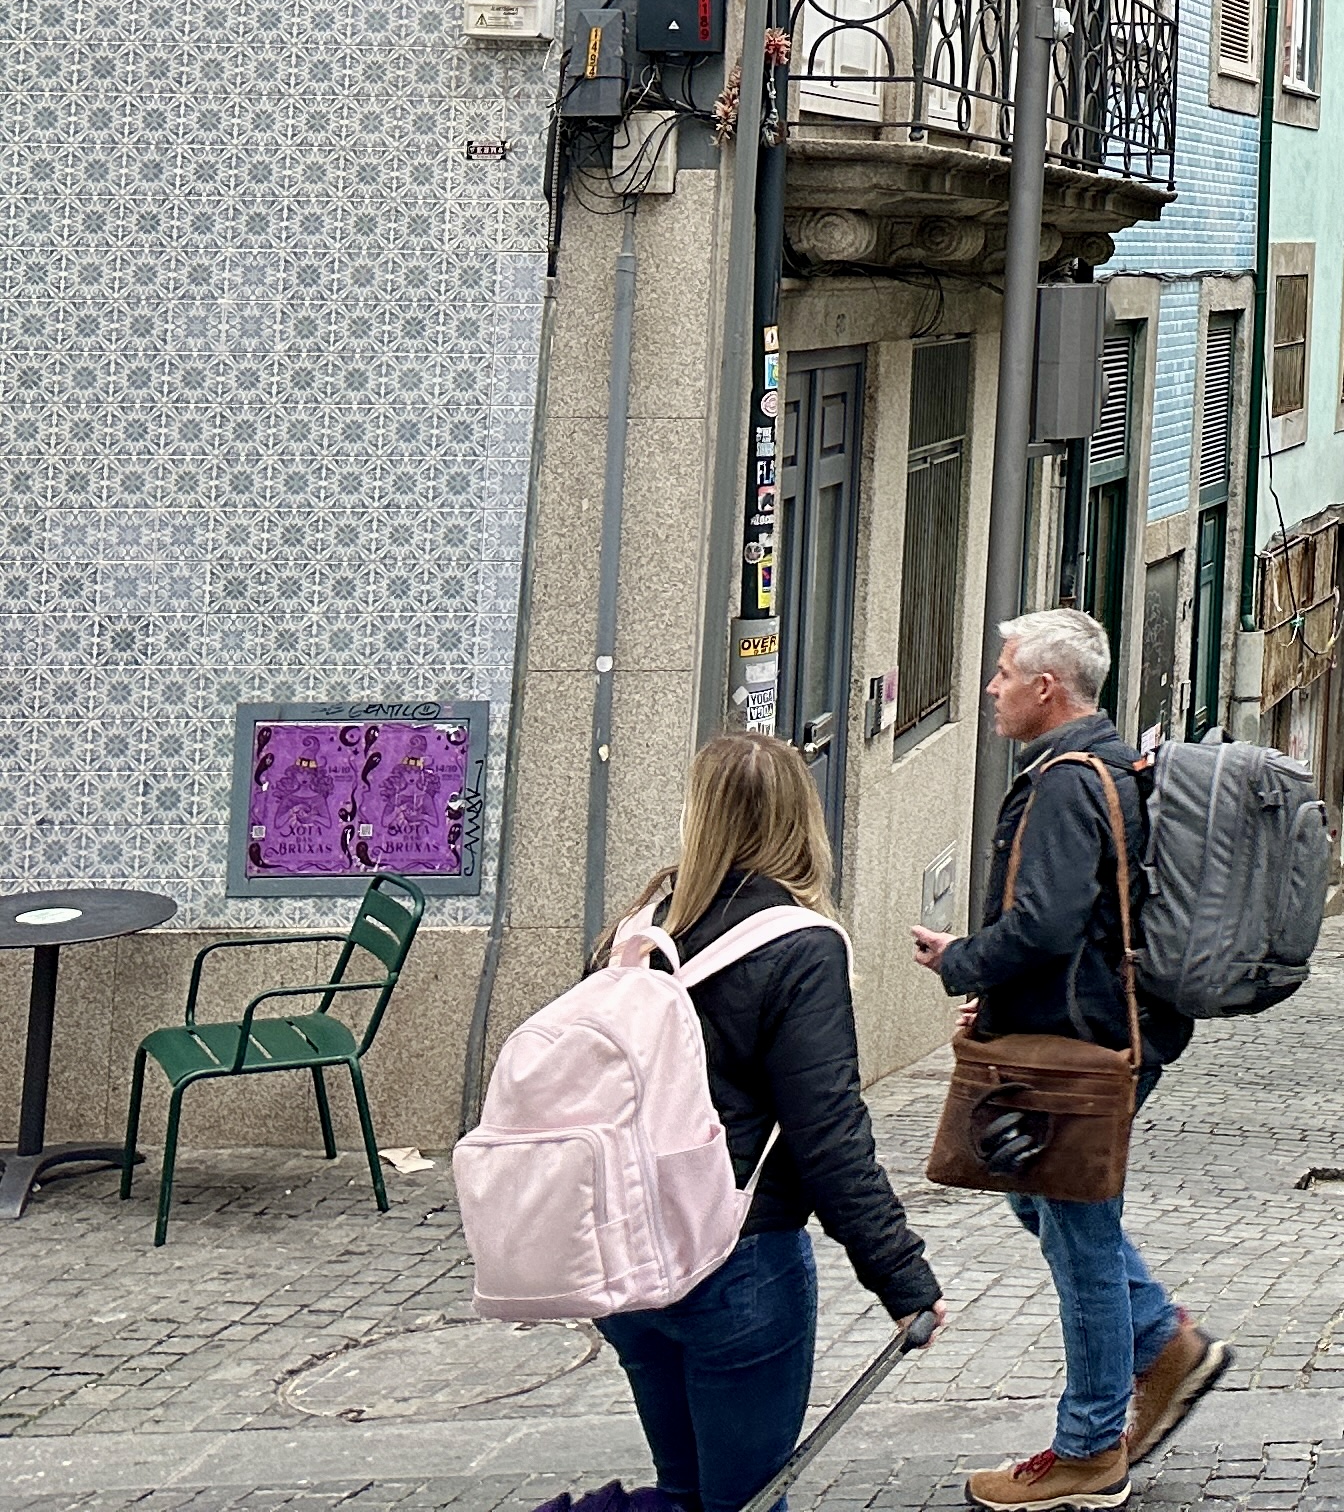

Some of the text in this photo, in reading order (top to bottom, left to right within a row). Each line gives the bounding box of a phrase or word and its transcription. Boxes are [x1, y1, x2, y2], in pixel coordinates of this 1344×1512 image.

[741, 636, 777, 651] OVER
[750, 690, 773, 705] YOGA
[266, 842, 333, 857] BRUXAS
[374, 841, 440, 856] BRUXAS
